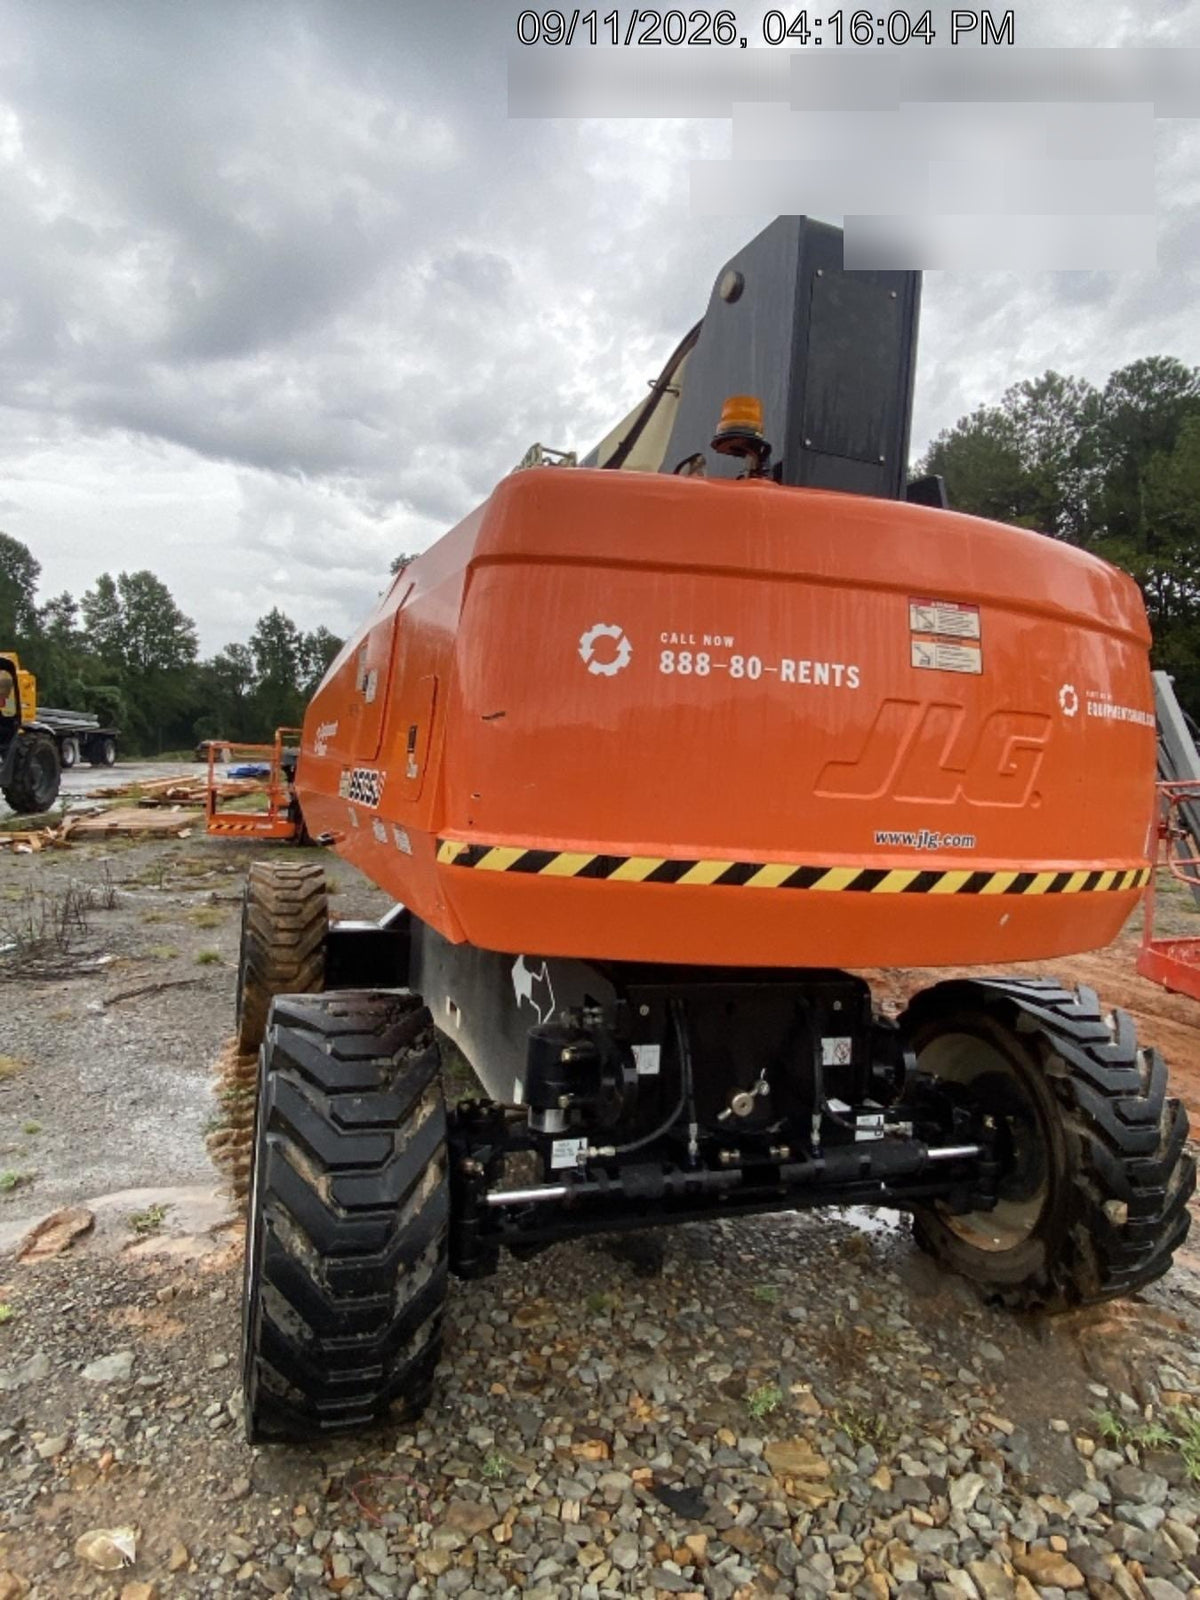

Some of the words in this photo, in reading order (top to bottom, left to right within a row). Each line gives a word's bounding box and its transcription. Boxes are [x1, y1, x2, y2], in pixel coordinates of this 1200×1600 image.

[660, 632, 696, 645] CALL
[703, 634, 734, 648] NOW
[874, 830, 976, 849] www.jlg.com
